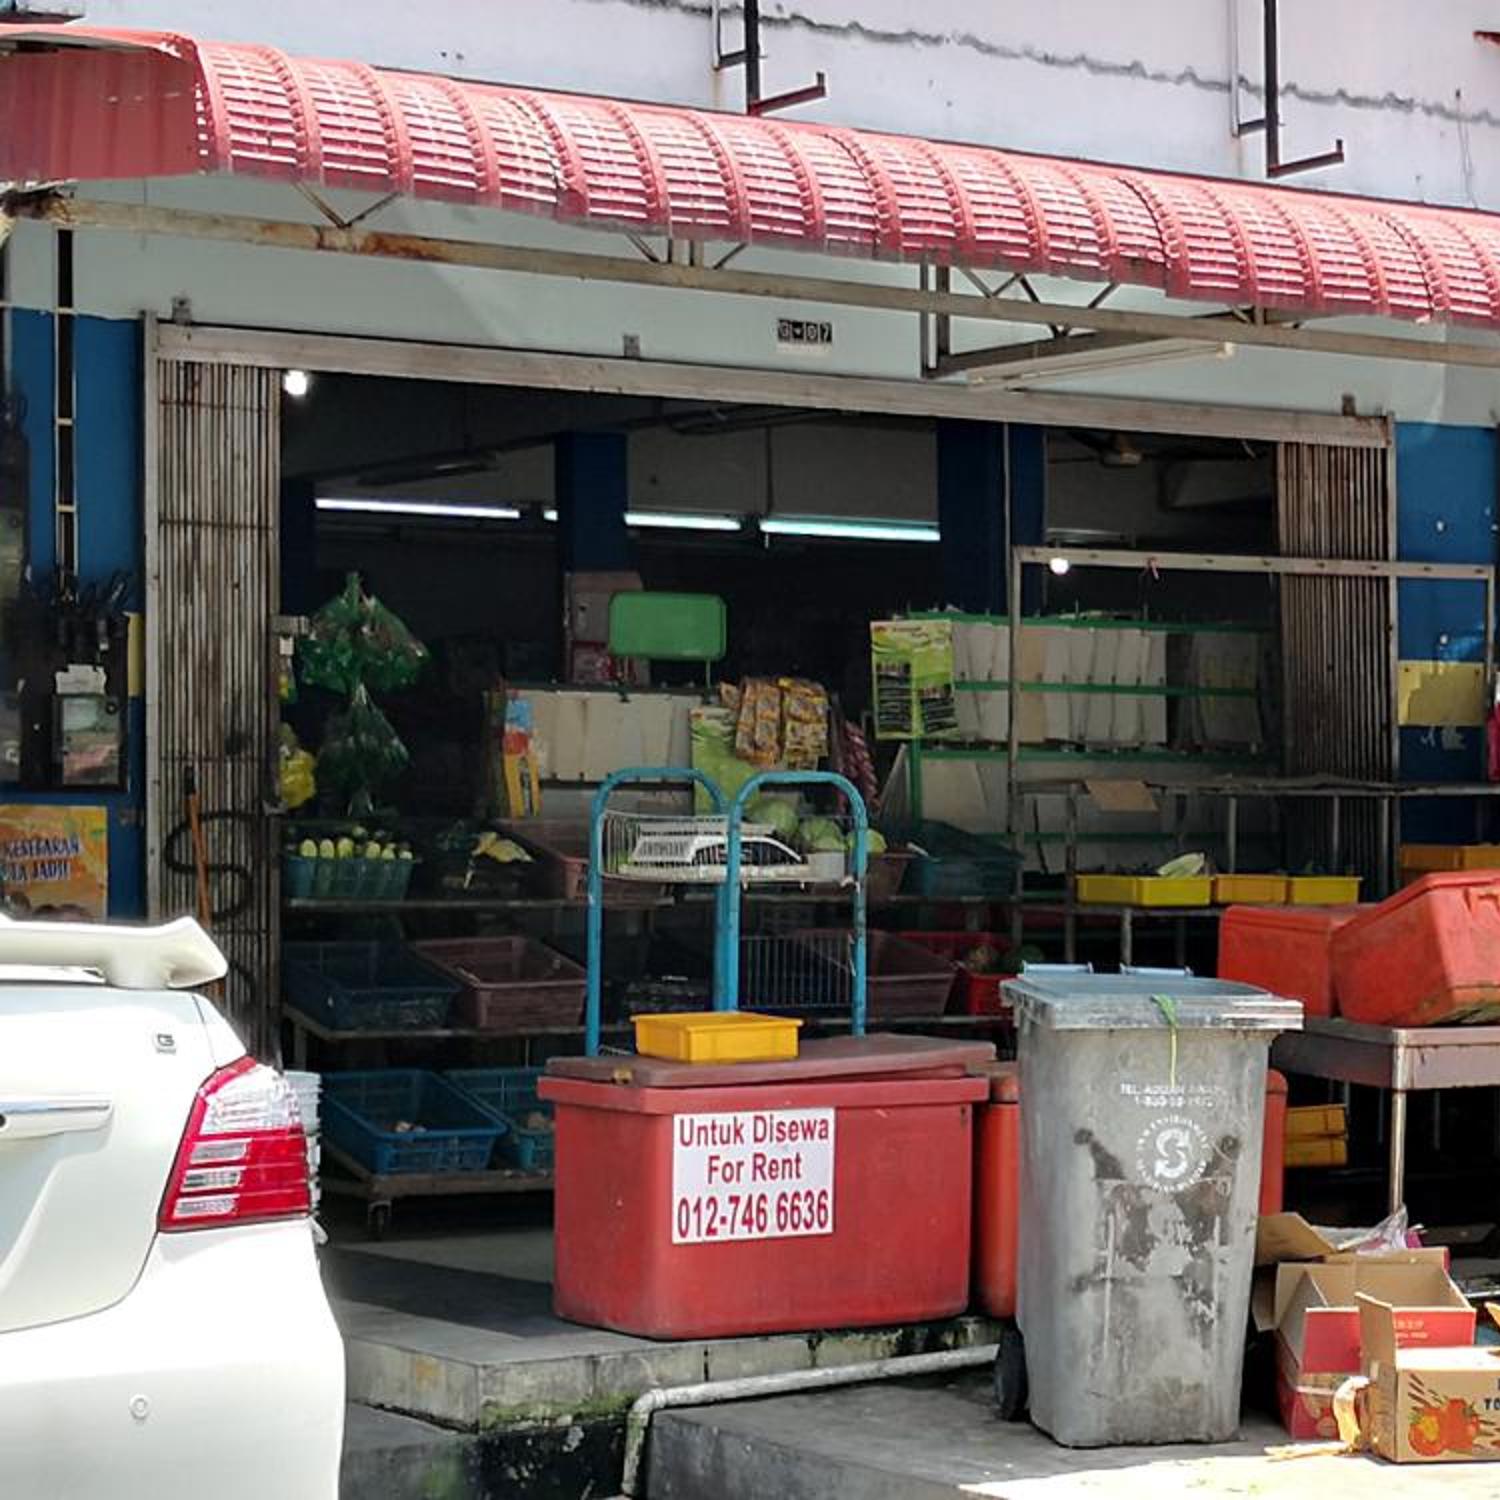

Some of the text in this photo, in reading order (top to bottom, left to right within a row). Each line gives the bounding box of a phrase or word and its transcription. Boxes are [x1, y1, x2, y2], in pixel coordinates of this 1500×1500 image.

[679, 1114, 829, 1147] Untuk Disewa
[707, 1152, 802, 1185] For Rent
[677, 1189, 829, 1239] 012-746 6636
